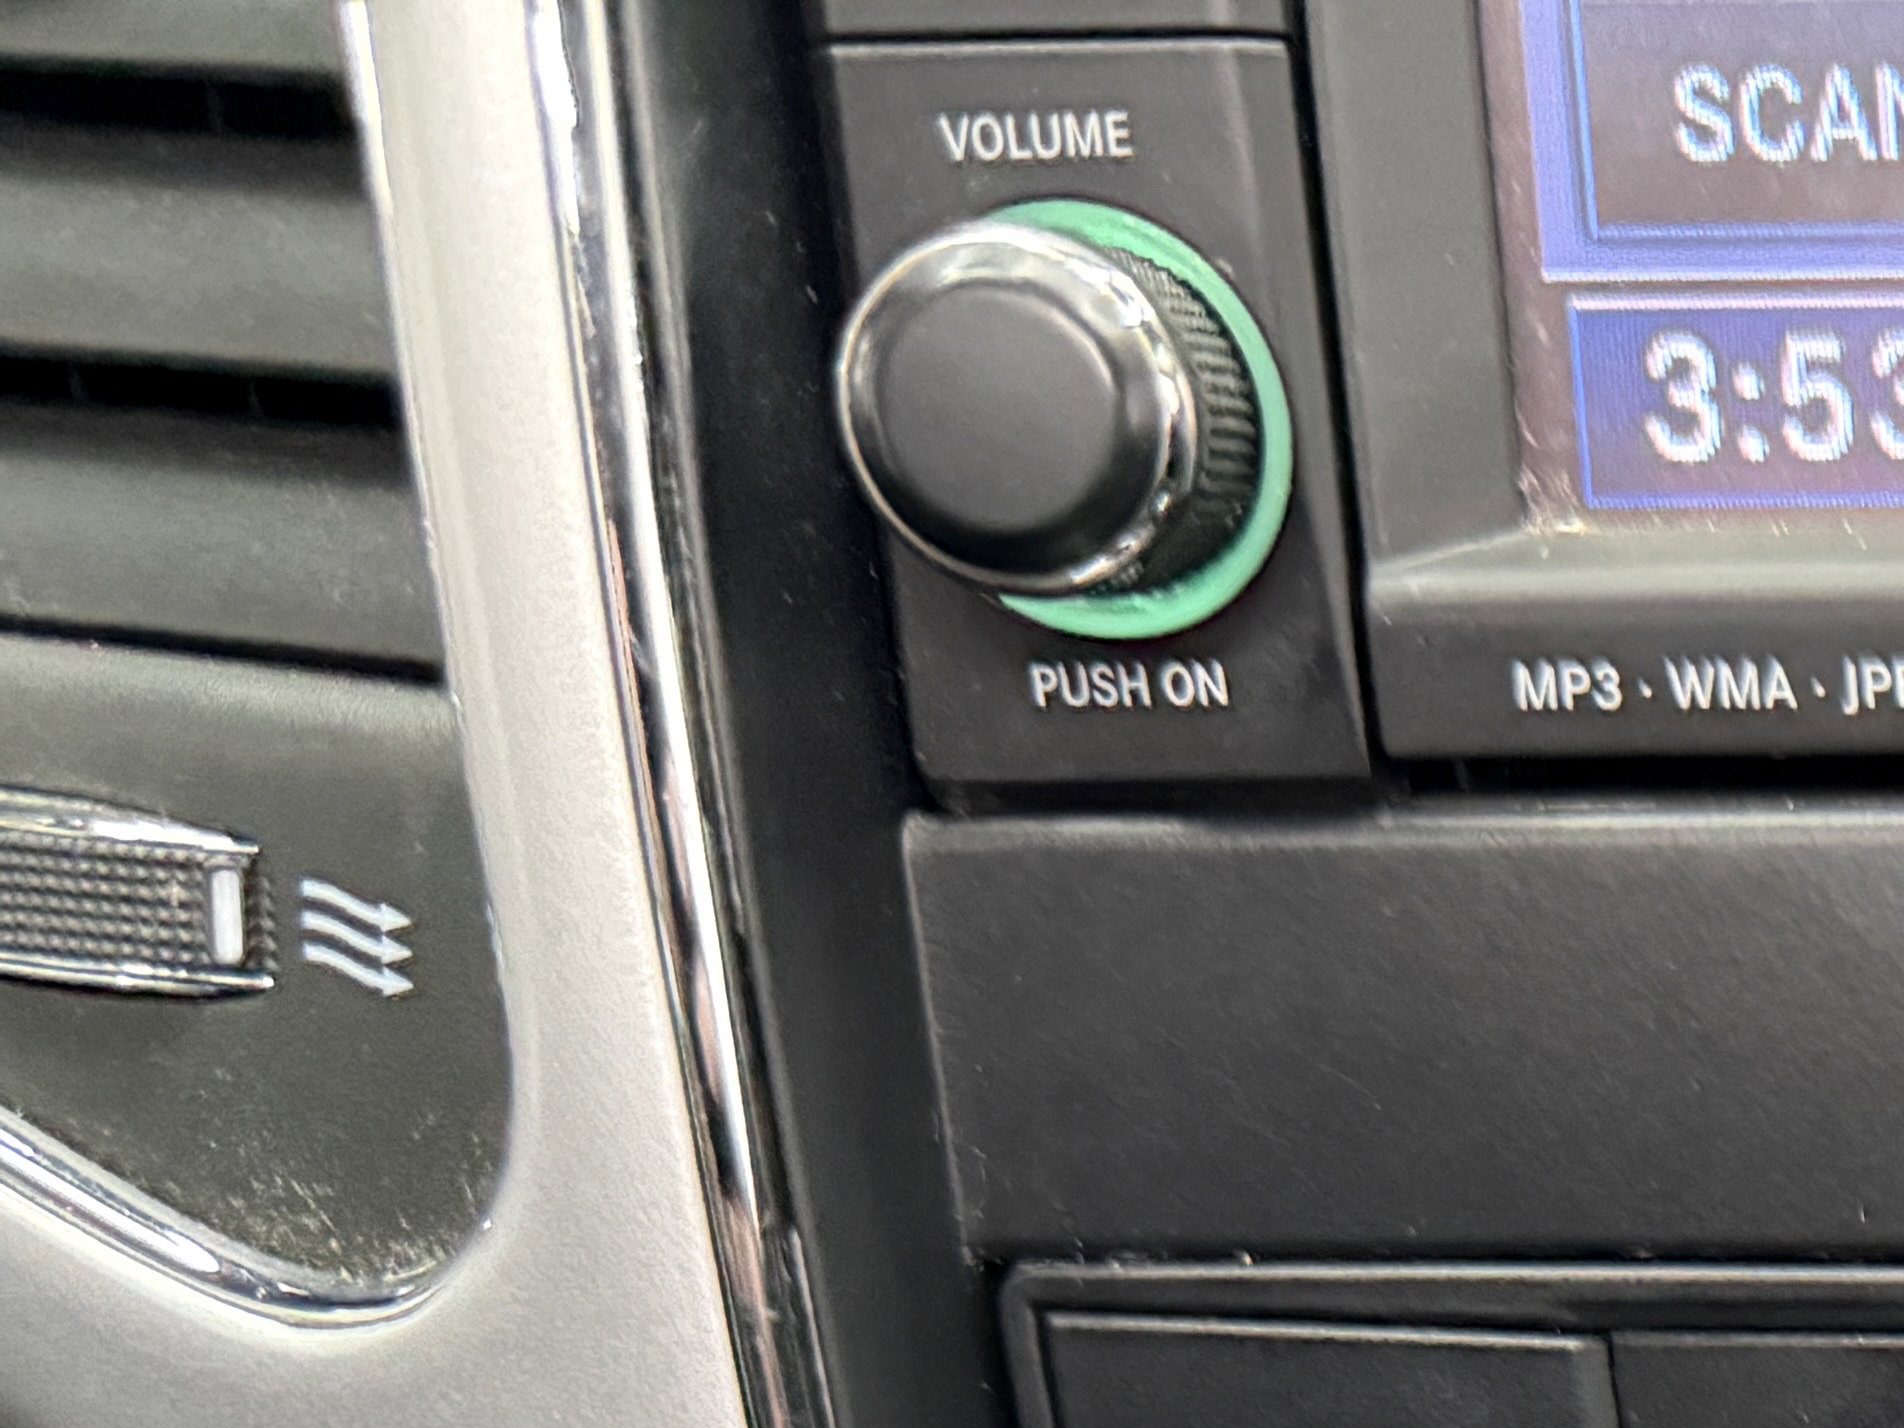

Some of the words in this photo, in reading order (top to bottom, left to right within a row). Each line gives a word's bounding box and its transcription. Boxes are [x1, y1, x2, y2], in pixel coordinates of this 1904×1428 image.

[936, 109, 1134, 161] VOLUME
[1029, 663, 1152, 708] PUSH
[1160, 661, 1229, 707] ON
[1512, 660, 1623, 710] MP3
[1665, 658, 1797, 710] WMA
